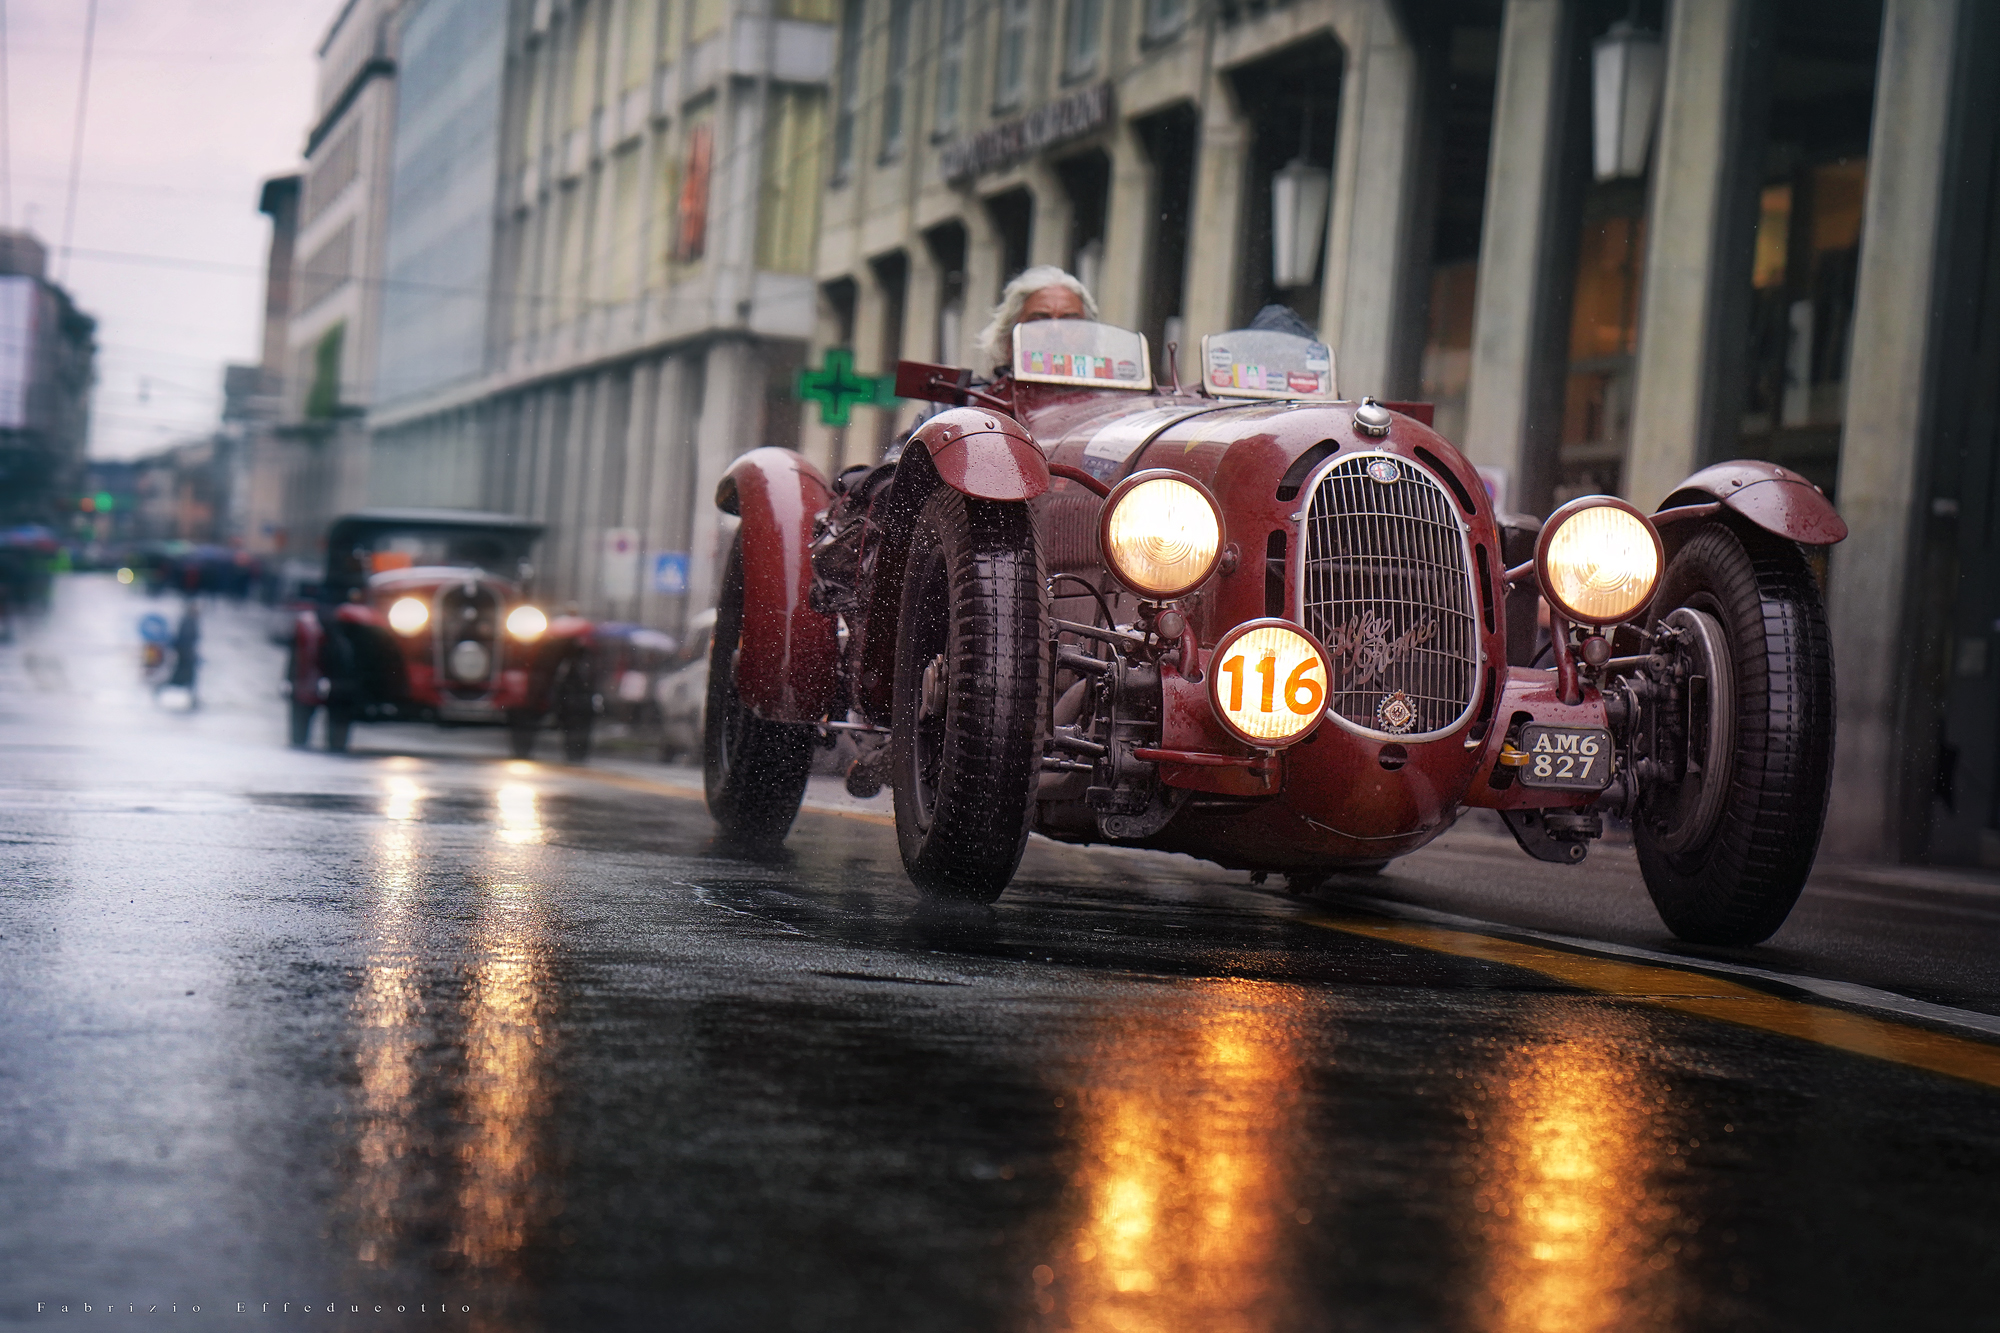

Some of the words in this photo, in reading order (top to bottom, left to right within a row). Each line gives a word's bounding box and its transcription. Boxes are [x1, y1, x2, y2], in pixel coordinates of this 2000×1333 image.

[1325, 609, 1392, 675] Alfa
[1222, 654, 1323, 716] 116
[1532, 733, 1599, 756] AM6
[1533, 754, 1595, 779] 827
